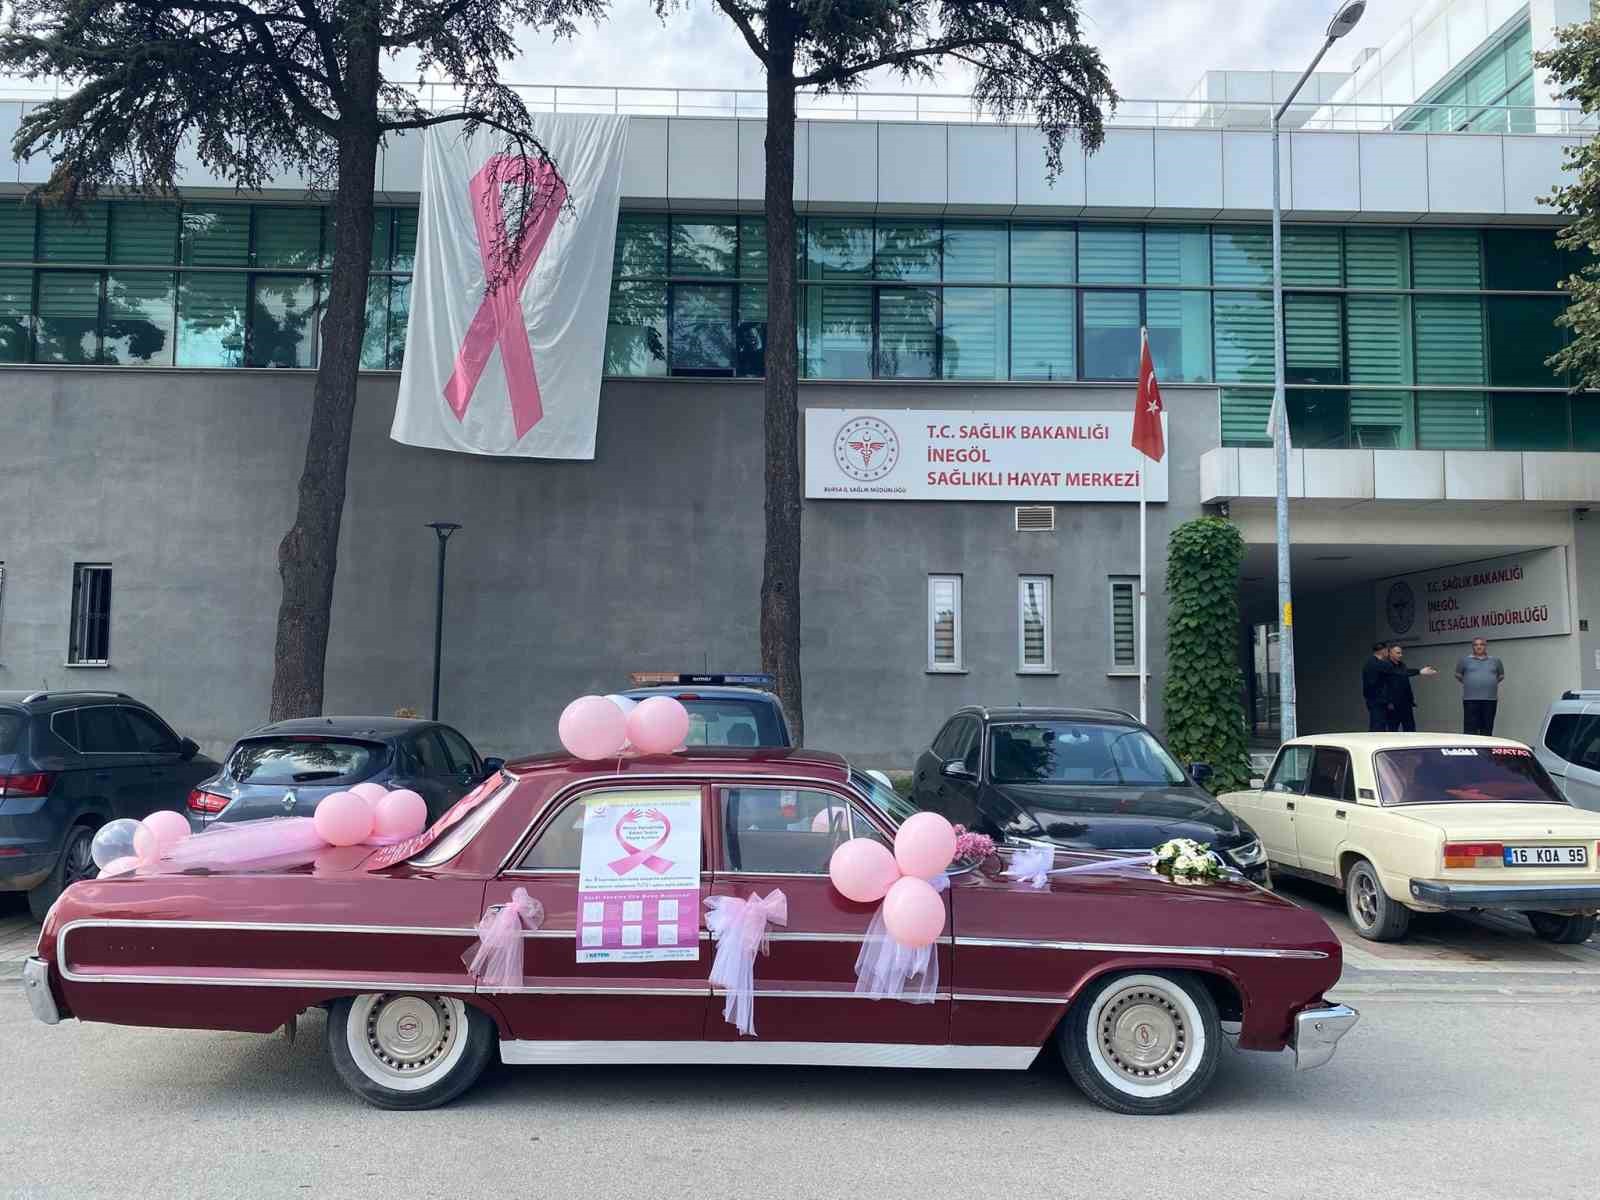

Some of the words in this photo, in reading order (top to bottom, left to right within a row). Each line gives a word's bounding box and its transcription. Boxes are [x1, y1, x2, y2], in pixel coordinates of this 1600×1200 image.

[927, 425, 955, 439] T.C.
[959, 423, 1016, 439] SAĞLIK
[1020, 424, 1109, 440] BAKANLIĞI
[927, 445, 991, 463] İNEGÖL
[927, 468, 1003, 486] SAĞLIKLI
[1007, 472, 1061, 487] HAYAT
[1065, 470, 1140, 487] MERKEZİ
[1473, 565, 1523, 586] BAKANLIĞI
[1481, 604, 1548, 628] MÜDÜRLÜĞÜ
[1512, 849, 1528, 863] 16
[1568, 849, 1584, 862] 95
